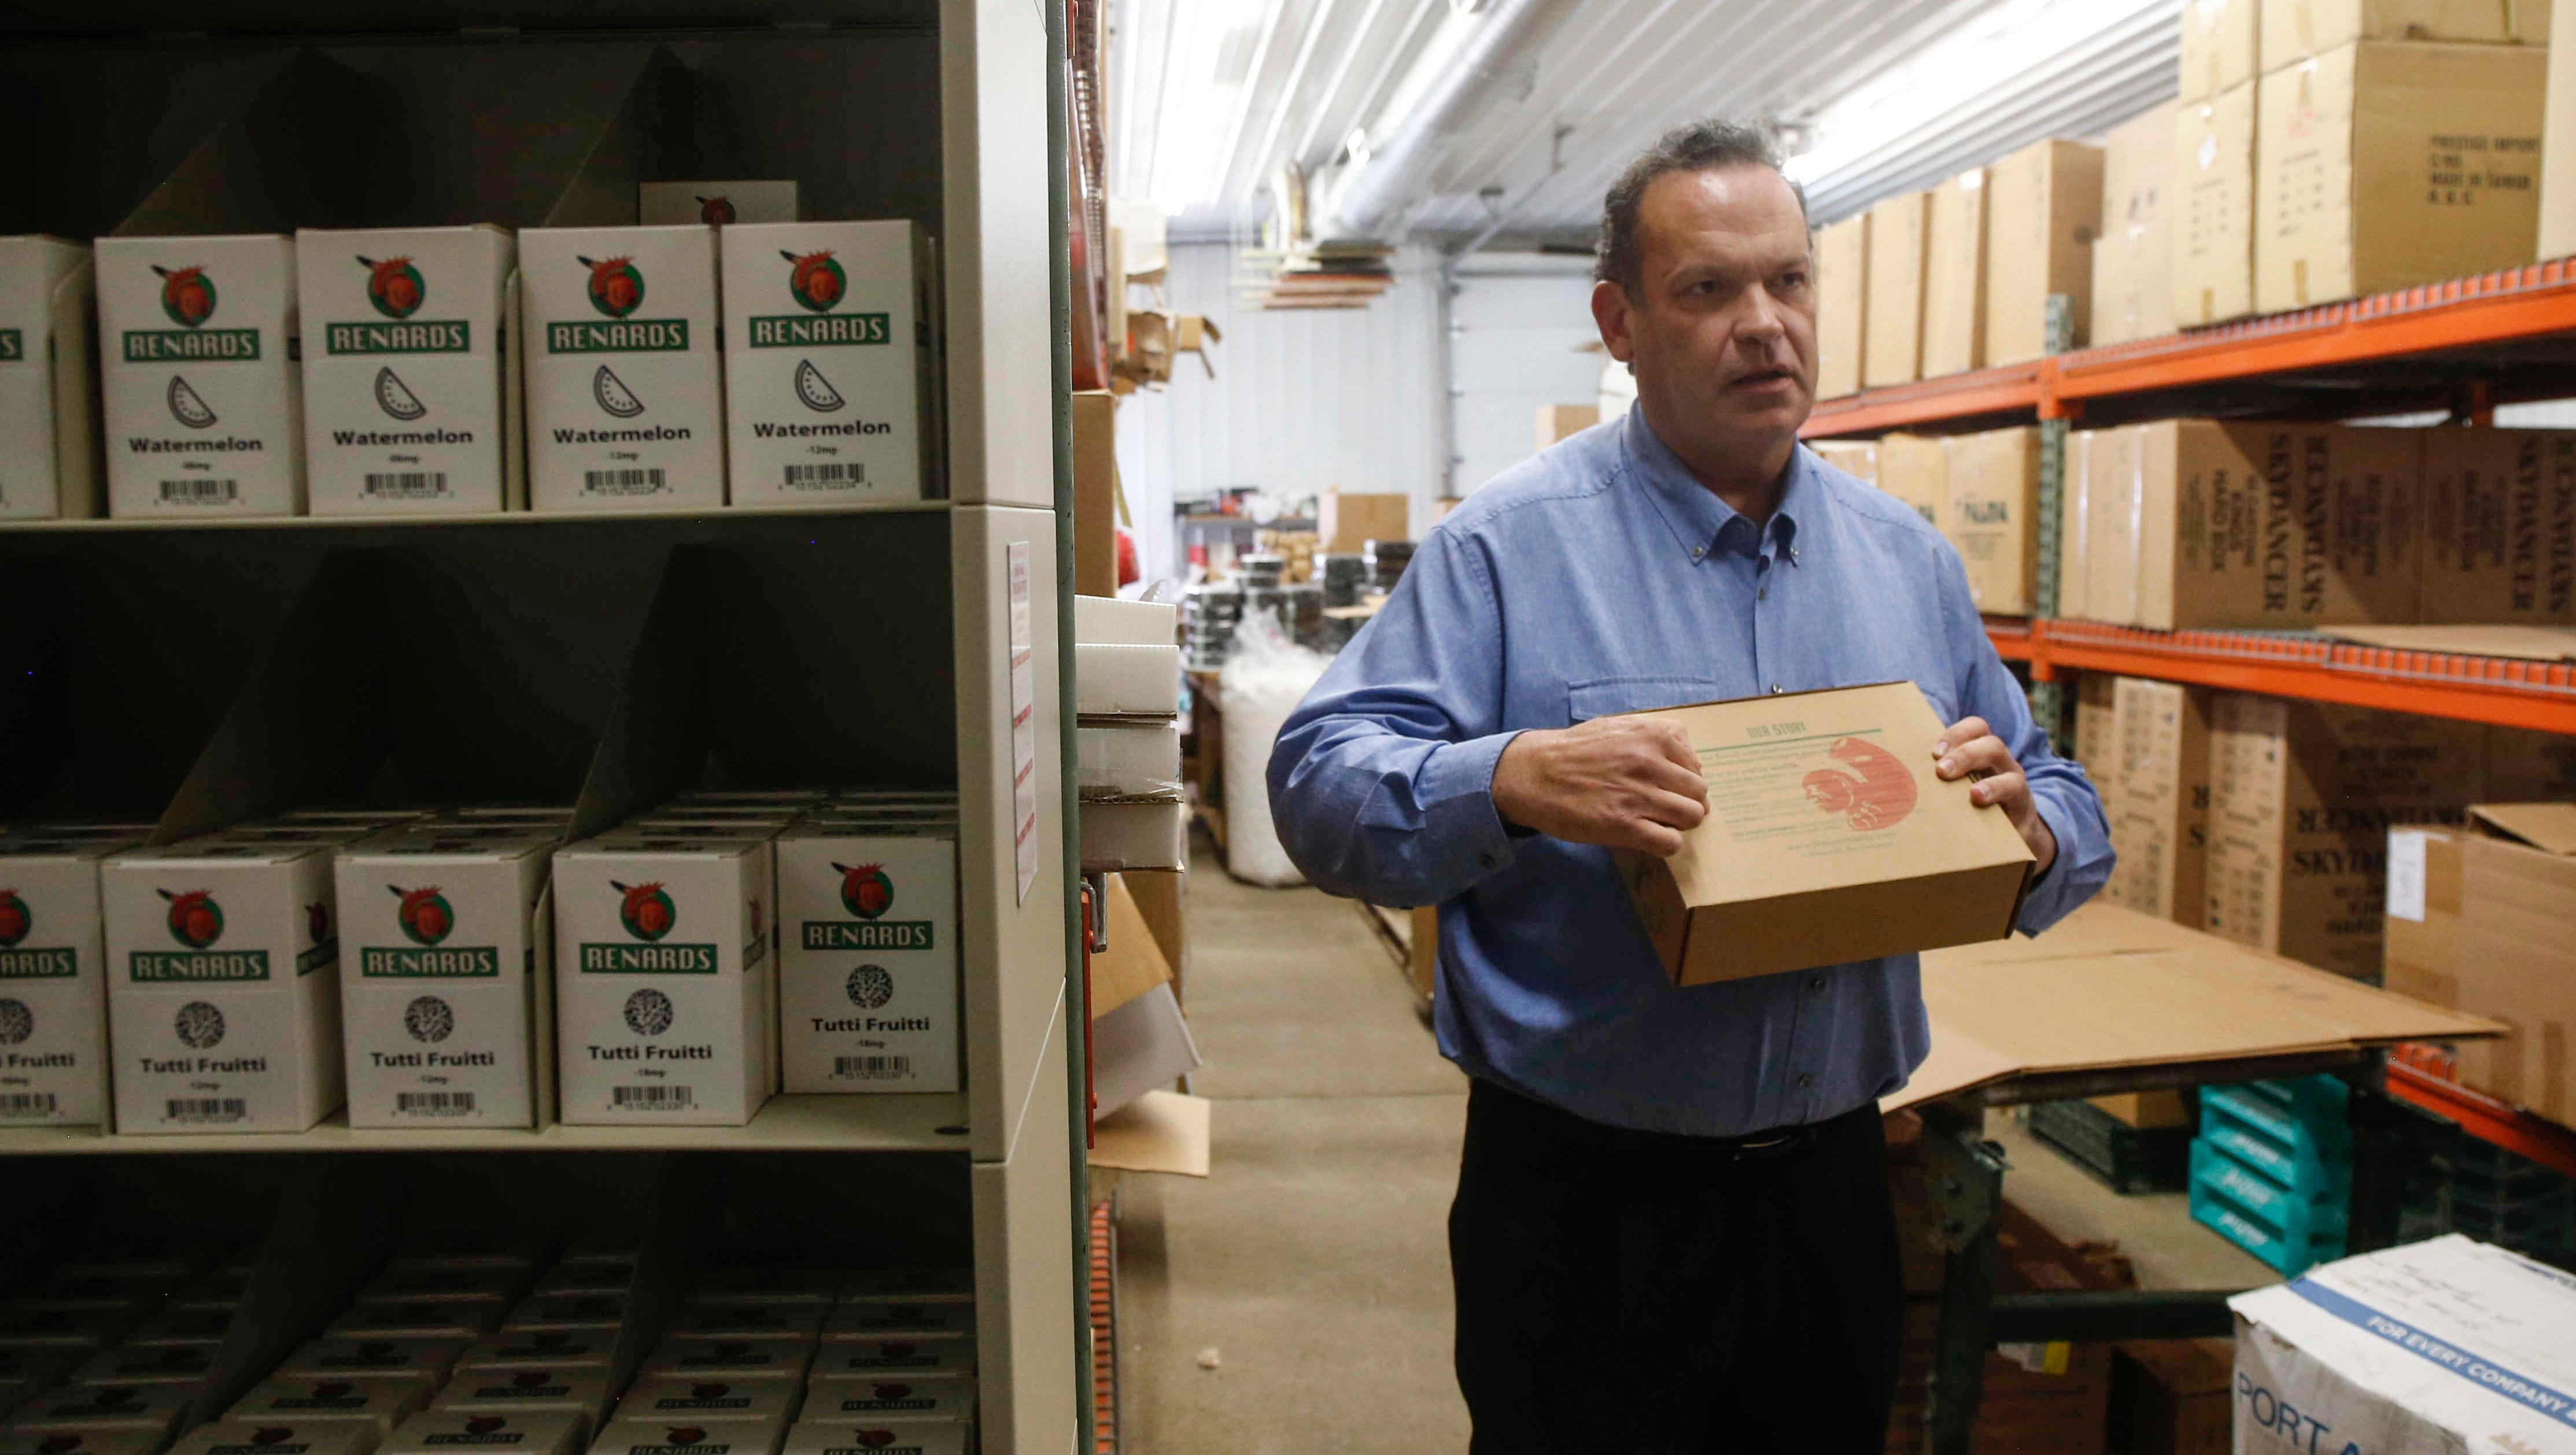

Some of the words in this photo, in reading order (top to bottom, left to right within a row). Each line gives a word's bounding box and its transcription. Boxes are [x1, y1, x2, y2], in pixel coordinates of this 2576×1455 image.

[334, 324, 463, 350] RENARDS
[555, 323, 682, 349] RENARDS
[756, 318, 884, 344] RENARDS
[129, 333, 254, 359] RENARDS
[333, 429, 473, 446] Watermelon
[553, 425, 691, 444] Watermelon
[754, 420, 891, 438] Watermelon
[128, 435, 263, 453] Watermelon
[1747, 726, 1770, 738] OUR
[1772, 721, 1807, 736] STORY
[809, 925, 927, 947] RENARDS
[0, 951, 71, 974] ARDS
[135, 955, 264, 977] RENARDS
[367, 951, 492, 974] RENARDS
[586, 947, 711, 971] RENARDS
[811, 1017, 861, 1032] Tutti
[866, 1017, 930, 1032] Fruitti
[8, 1053, 75, 1068] Fruitti
[371, 1051, 421, 1066] Tutti
[427, 1051, 494, 1066] Fruitti
[588, 1045, 639, 1060] Tutti
[646, 1044, 713, 1059] Fruitti
[139, 1057, 191, 1073] Tutti
[197, 1054, 267, 1073] Fruitti
[2367, 1315, 2408, 1340] FOR
[2404, 1333, 2470, 1368] EVERY
[2467, 1363, 2570, 1412] COMPANY
